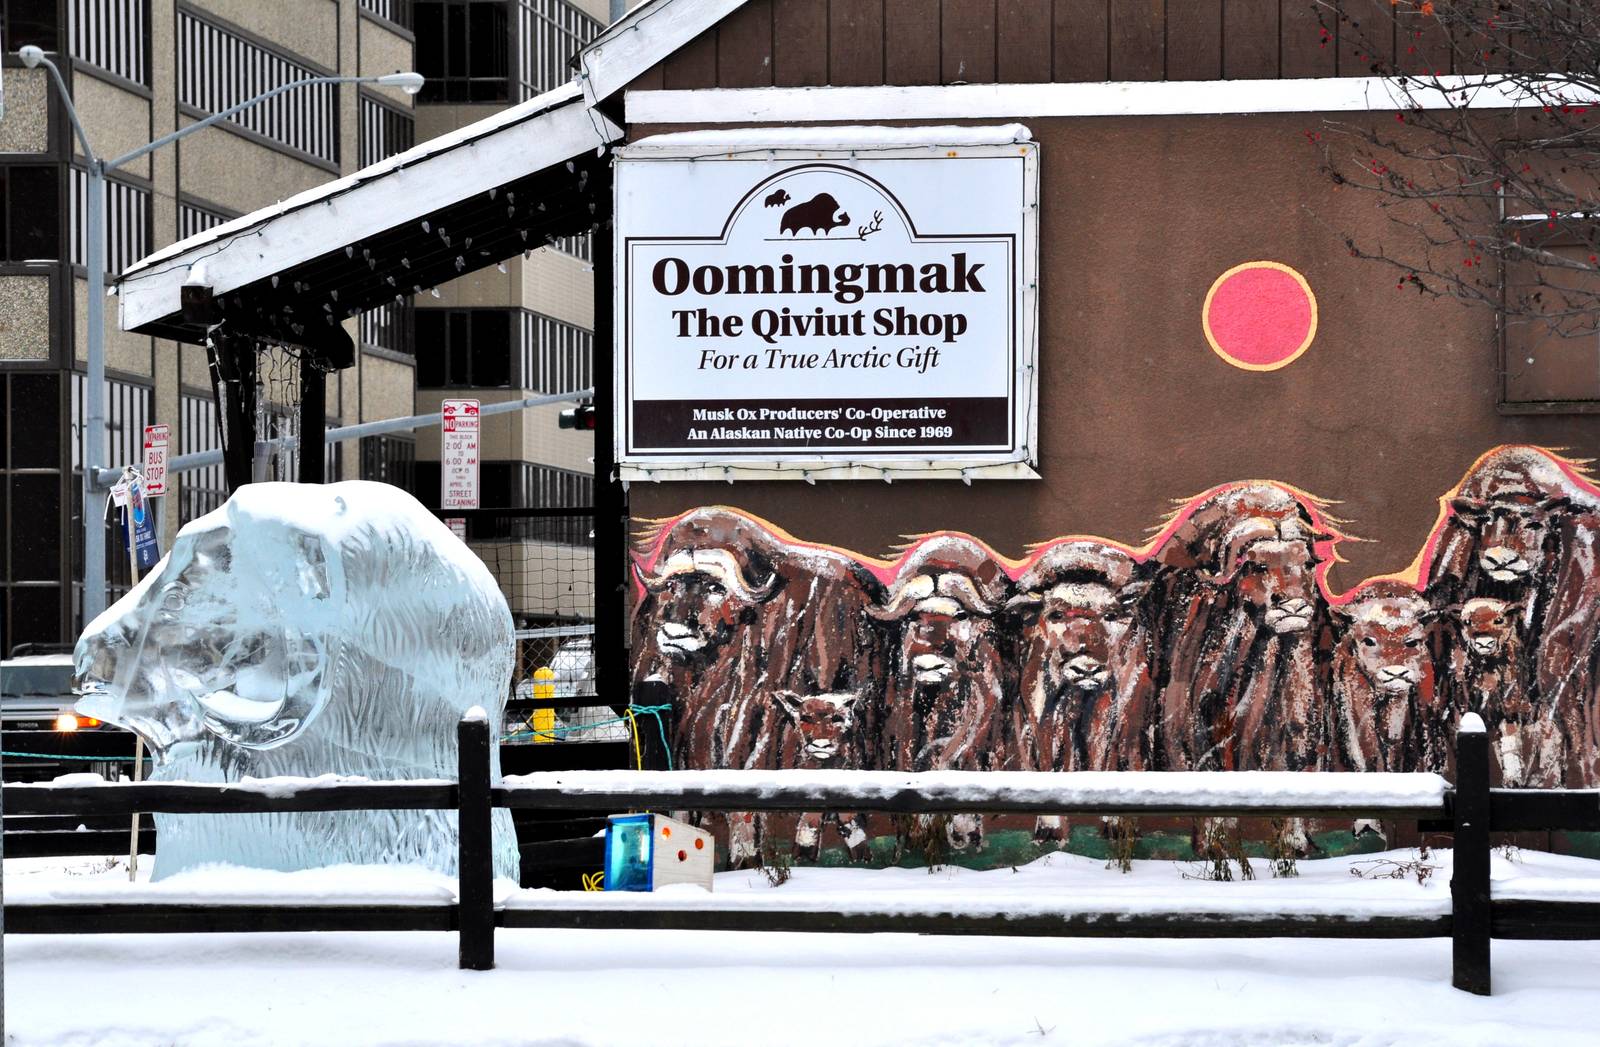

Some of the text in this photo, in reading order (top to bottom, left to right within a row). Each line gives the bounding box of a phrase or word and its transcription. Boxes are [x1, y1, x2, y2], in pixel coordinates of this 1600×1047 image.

[652, 252, 986, 304] Oomingmak
[672, 306, 968, 344] The Qiviut Shop
[697, 345, 941, 374] For a True Arctic Gift
[693, 407, 947, 421] Musk Ox Producers' Co-Operative
[444, 417, 479, 430] NO PARKING
[687, 426, 953, 441] An Alaskan Native Co-Op Since 1969
[148, 451, 162, 465] BUS
[467, 457, 476, 465] AM
[146, 466, 164, 481] STOP
[449, 490, 472, 498] STREET
[445, 499, 476, 507] CLEANING
